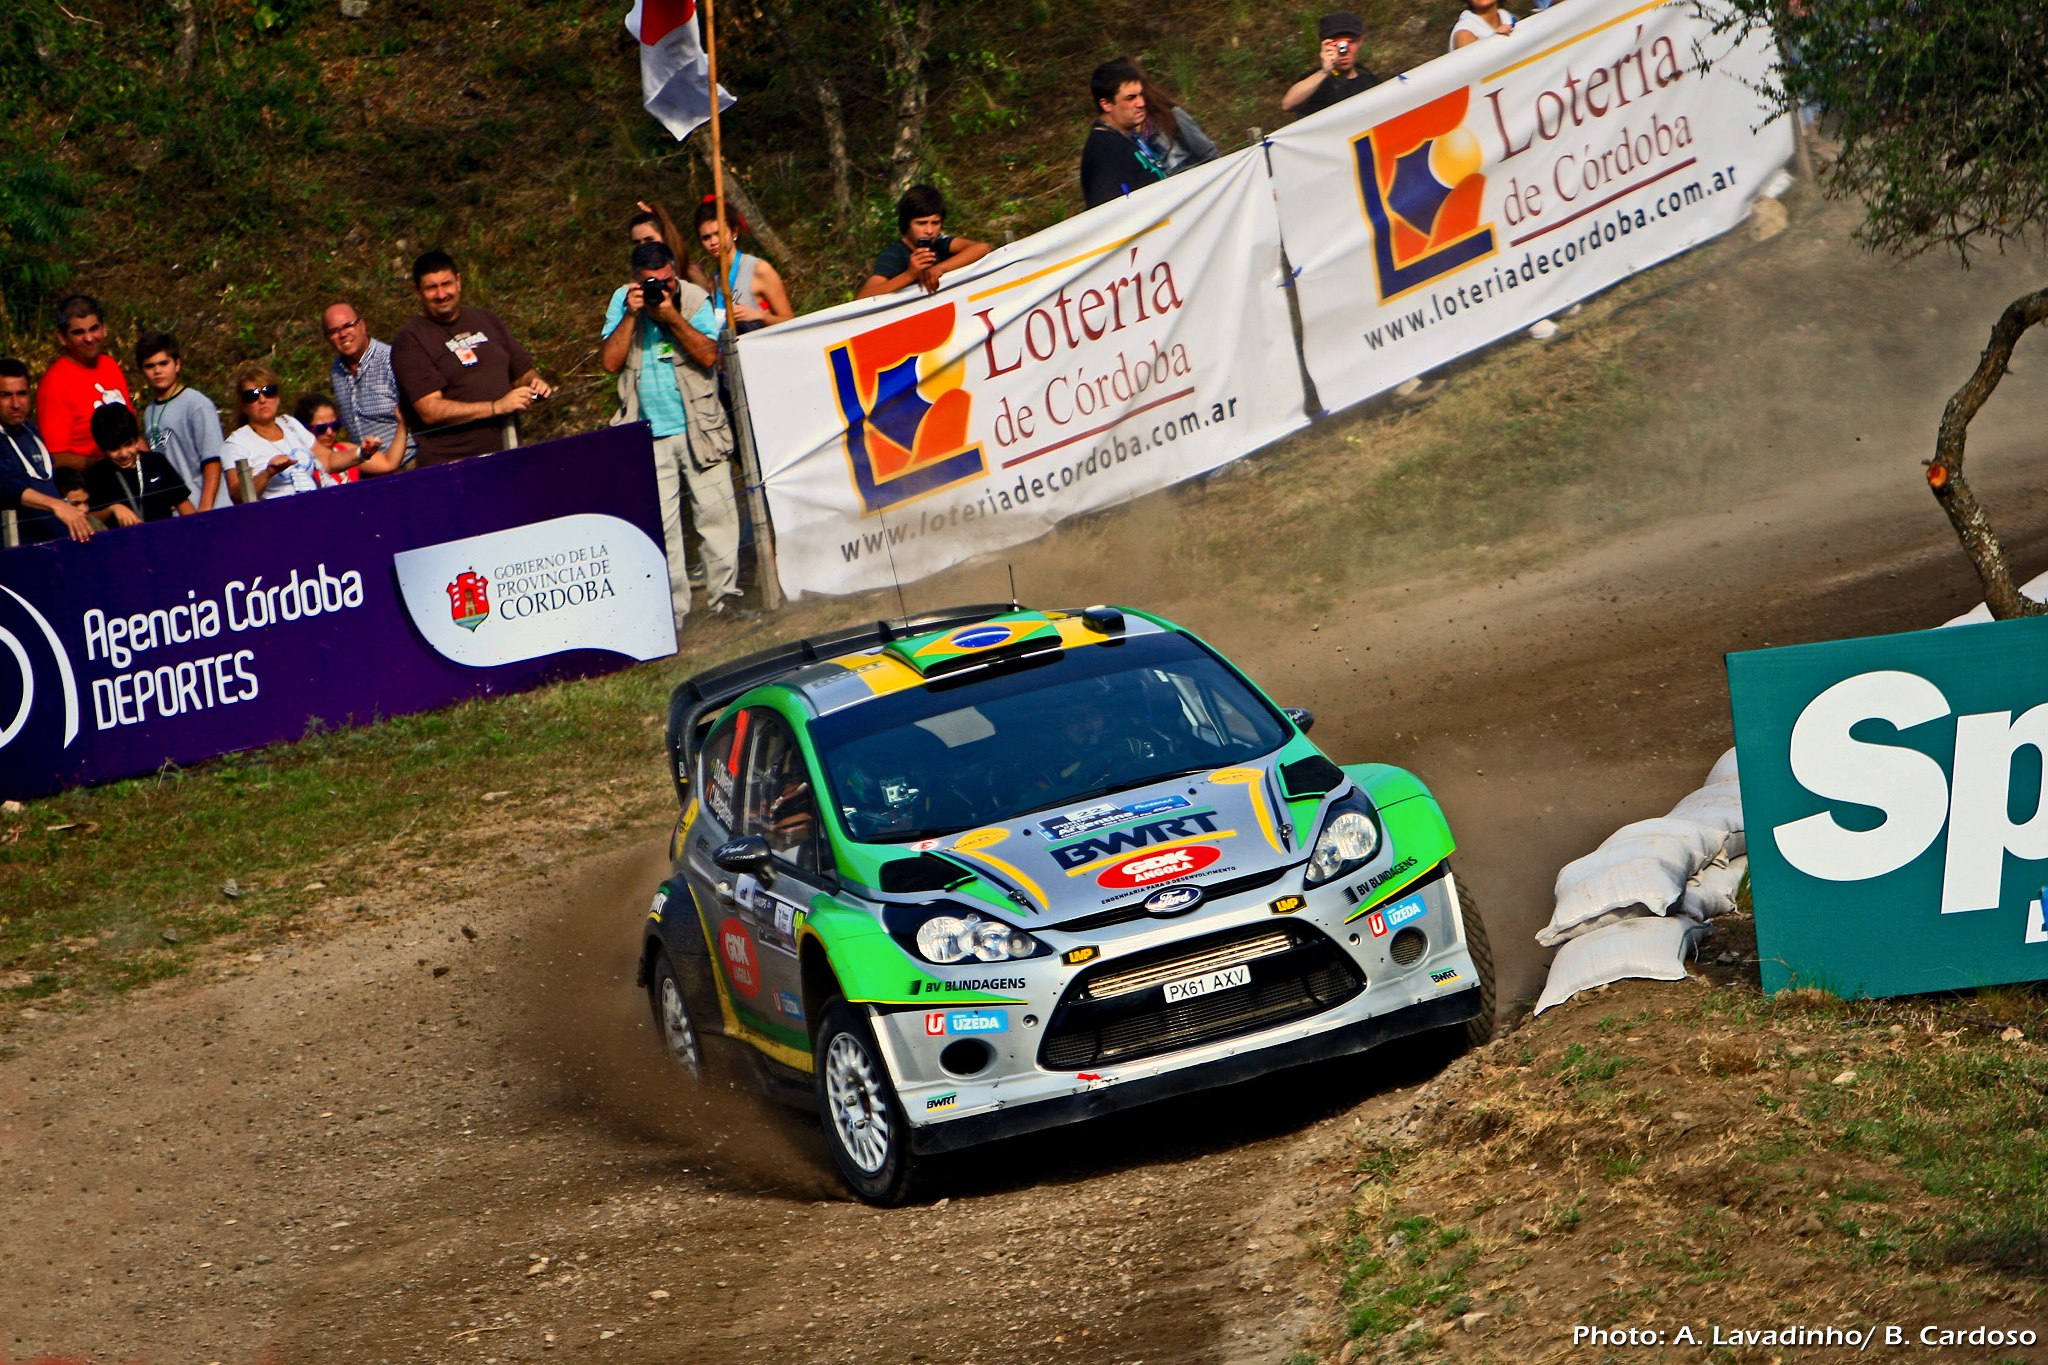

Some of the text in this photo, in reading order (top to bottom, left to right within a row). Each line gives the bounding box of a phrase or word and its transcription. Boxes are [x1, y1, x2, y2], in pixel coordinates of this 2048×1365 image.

[1484, 25, 1681, 162] Lotería
[1502, 111, 1693, 227] de Córdoba
[1364, 164, 1738, 352] www.loteriadecordoba.com.ar
[972, 247, 1183, 381] Lotería
[994, 340, 1192, 448] de Córdoba
[840, 397, 1238, 564] www.loteriadecordoba.com.ar
[494, 545, 608, 580] GOBIERNO DE LA
[497, 560, 611, 598] PROVINCIA DE
[83, 563, 363, 669] Agencia Córdoba
[500, 578, 615, 621] CÓRDOBA
[92, 649, 258, 730] DEPORTES
[1773, 670, 2048, 914] Sp
[1079, 807, 1104, 817] 22
[1049, 811, 1218, 870] BWRT
[1122, 849, 1195, 876] GDK
[1135, 862, 1194, 883] ANGOLA
[1356, 856, 1418, 896] BV BLINDAGENS
[1101, 887, 1145, 904] ENGENHARIA
[1146, 882, 1164, 891] PARA
[1172, 866, 1236, 884] DESENVOLVIMENTO
[1158, 889, 1191, 909] Ford
[1276, 897, 1298, 912] LMP
[1069, 948, 1093, 963] LMP
[925, 978, 1026, 992] BV BLINDAGENS
[1169, 968, 1245, 1000] PX61 AXV
[1431, 969, 1457, 983] BWRT
[926, 1094, 957, 1109] BWRT
